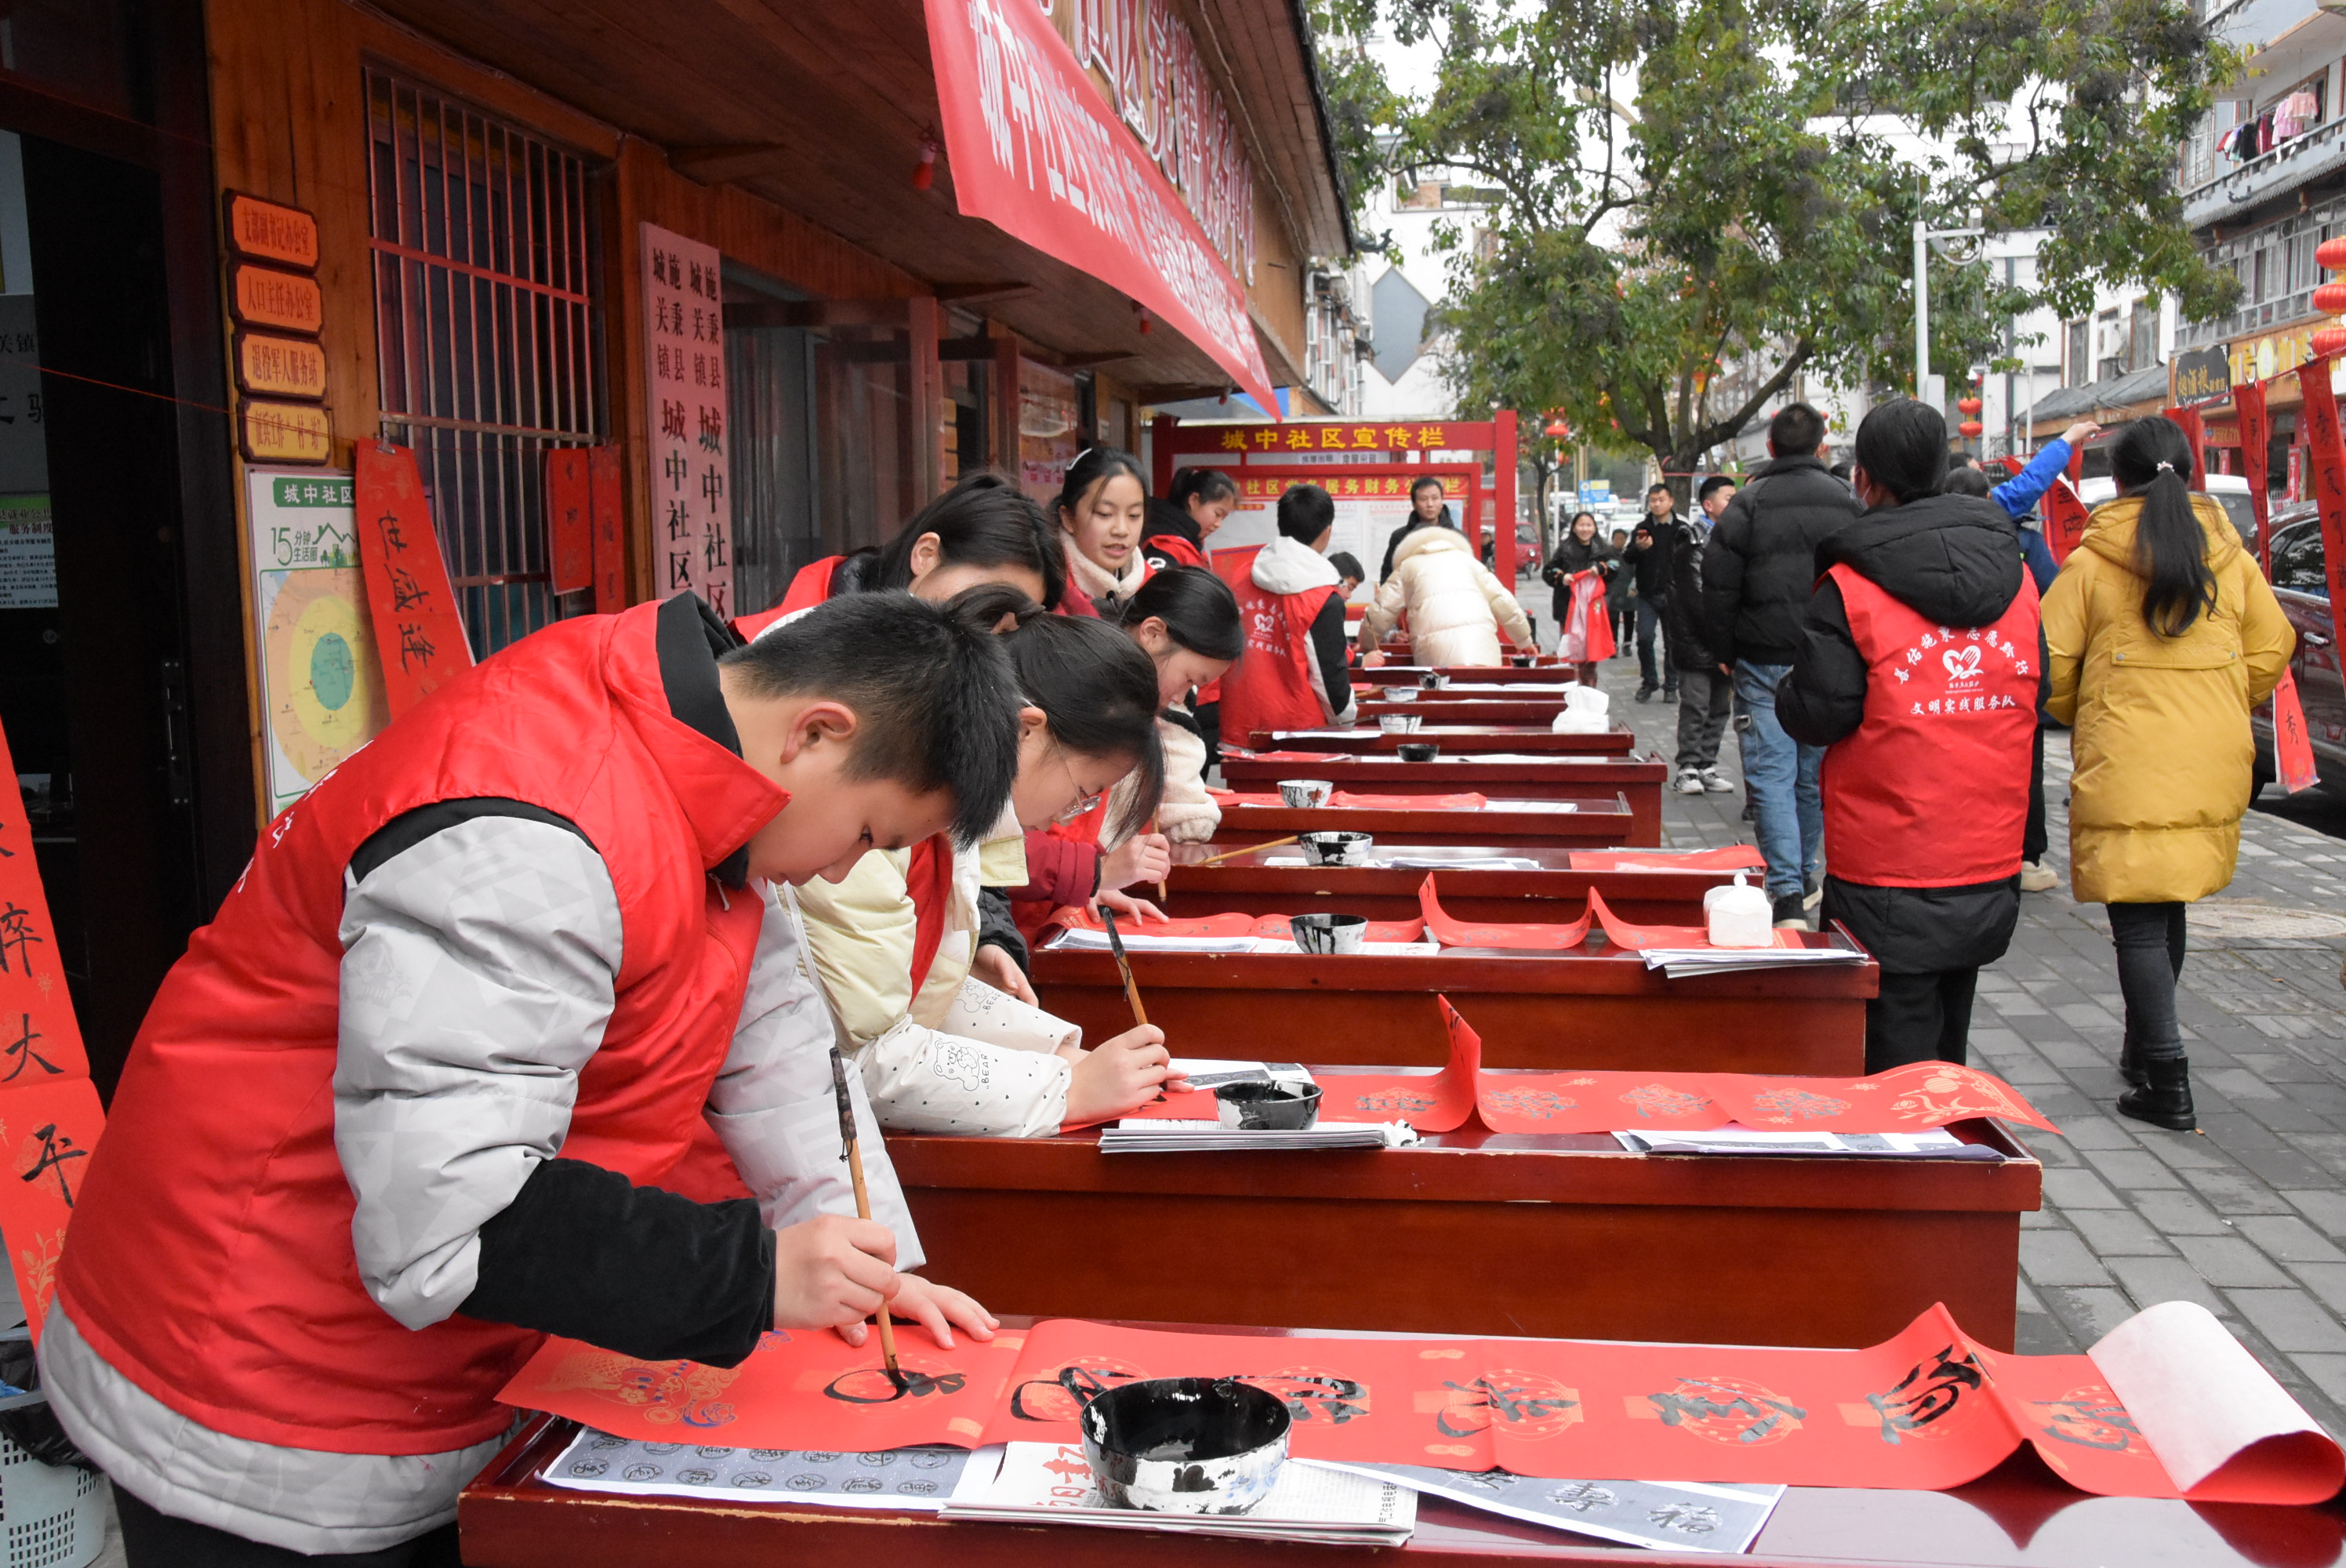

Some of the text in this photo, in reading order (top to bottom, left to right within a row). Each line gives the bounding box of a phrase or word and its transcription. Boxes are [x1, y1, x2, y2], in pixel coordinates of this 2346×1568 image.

[1039, 0, 1253, 285] 区党群服务中心
[653, 248, 670, 381] 城关镇
[668, 252, 685, 383] 施秉县
[690, 260, 706, 387] 城关镇
[704, 265, 721, 390] 施秉县
[252, 344, 318, 387] 退役军人服务站
[1221, 426, 1446, 450] 城中社区宣传栏
[284, 484, 355, 504] 城中社区
[661, 399, 693, 590] 城中社区
[698, 405, 728, 627] 城中社区
[271, 527, 293, 566] 15
[293, 546, 318, 562] 生活圈
[294, 531, 311, 546] 分钟
[1910, 695, 2016, 716] 文明实践服务队
